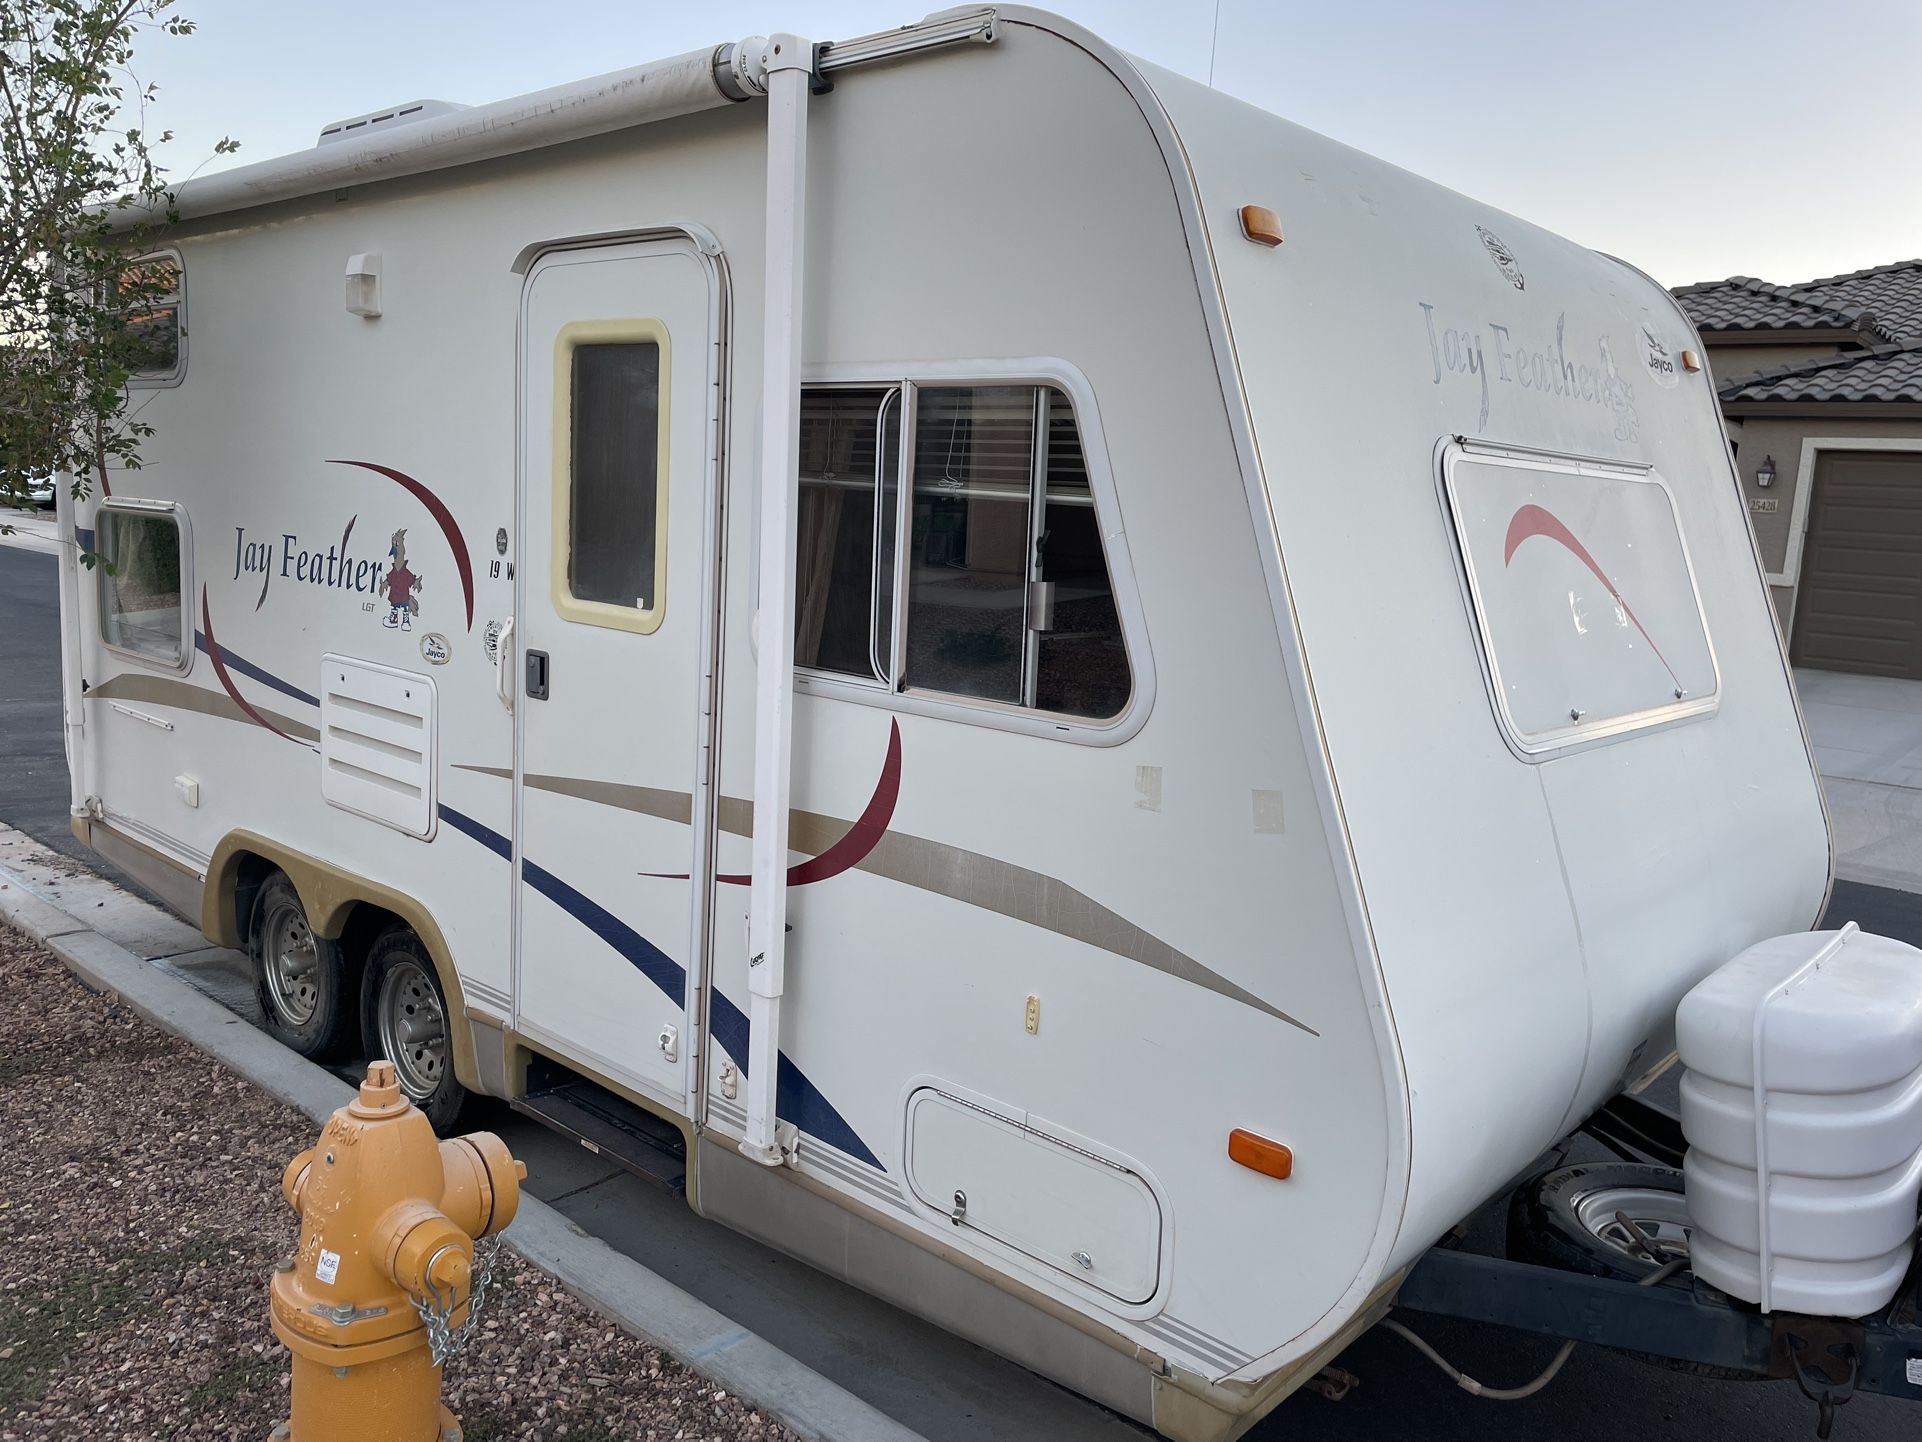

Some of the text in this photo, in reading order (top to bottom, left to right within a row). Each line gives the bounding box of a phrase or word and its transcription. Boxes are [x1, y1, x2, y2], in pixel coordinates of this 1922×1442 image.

[1418, 301, 1603, 433] Jay Feather
[1647, 353, 1673, 373] Jayco
[1749, 500, 1776, 511] 25428
[234, 514, 383, 612] Jay Feather
[489, 560, 501, 579] 19
[361, 602, 376, 613] LGT
[425, 648, 446, 659] Jayco
[321, 1256, 336, 1269] NSF
